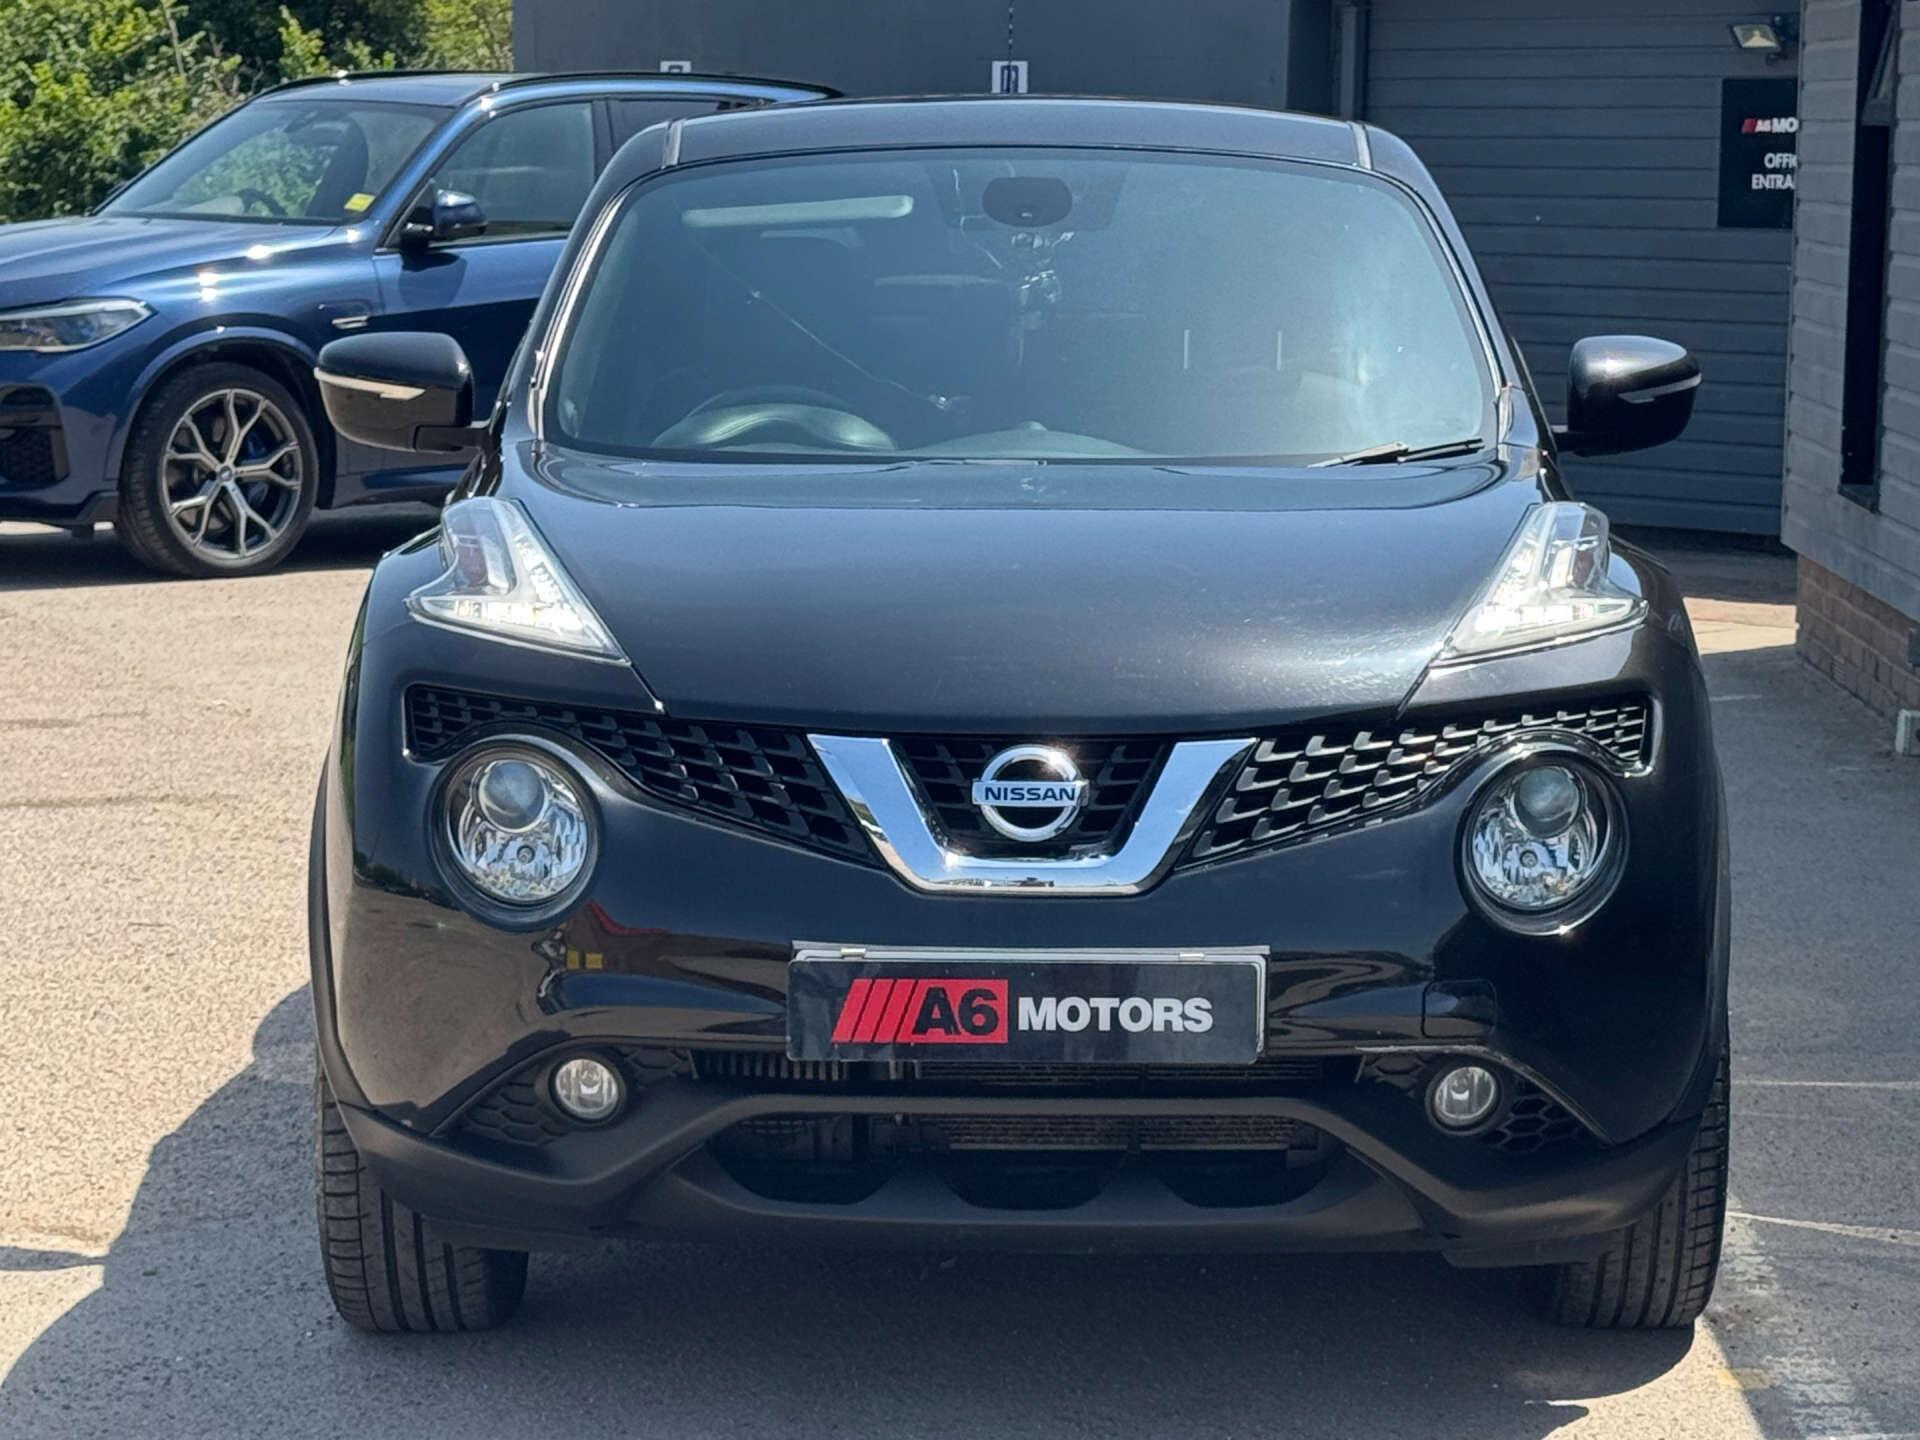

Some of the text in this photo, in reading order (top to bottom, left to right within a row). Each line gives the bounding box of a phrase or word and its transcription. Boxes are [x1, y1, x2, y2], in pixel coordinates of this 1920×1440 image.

[984, 786, 1076, 802] NISSAN
[911, 985, 1213, 1036] A6 MOTORS
